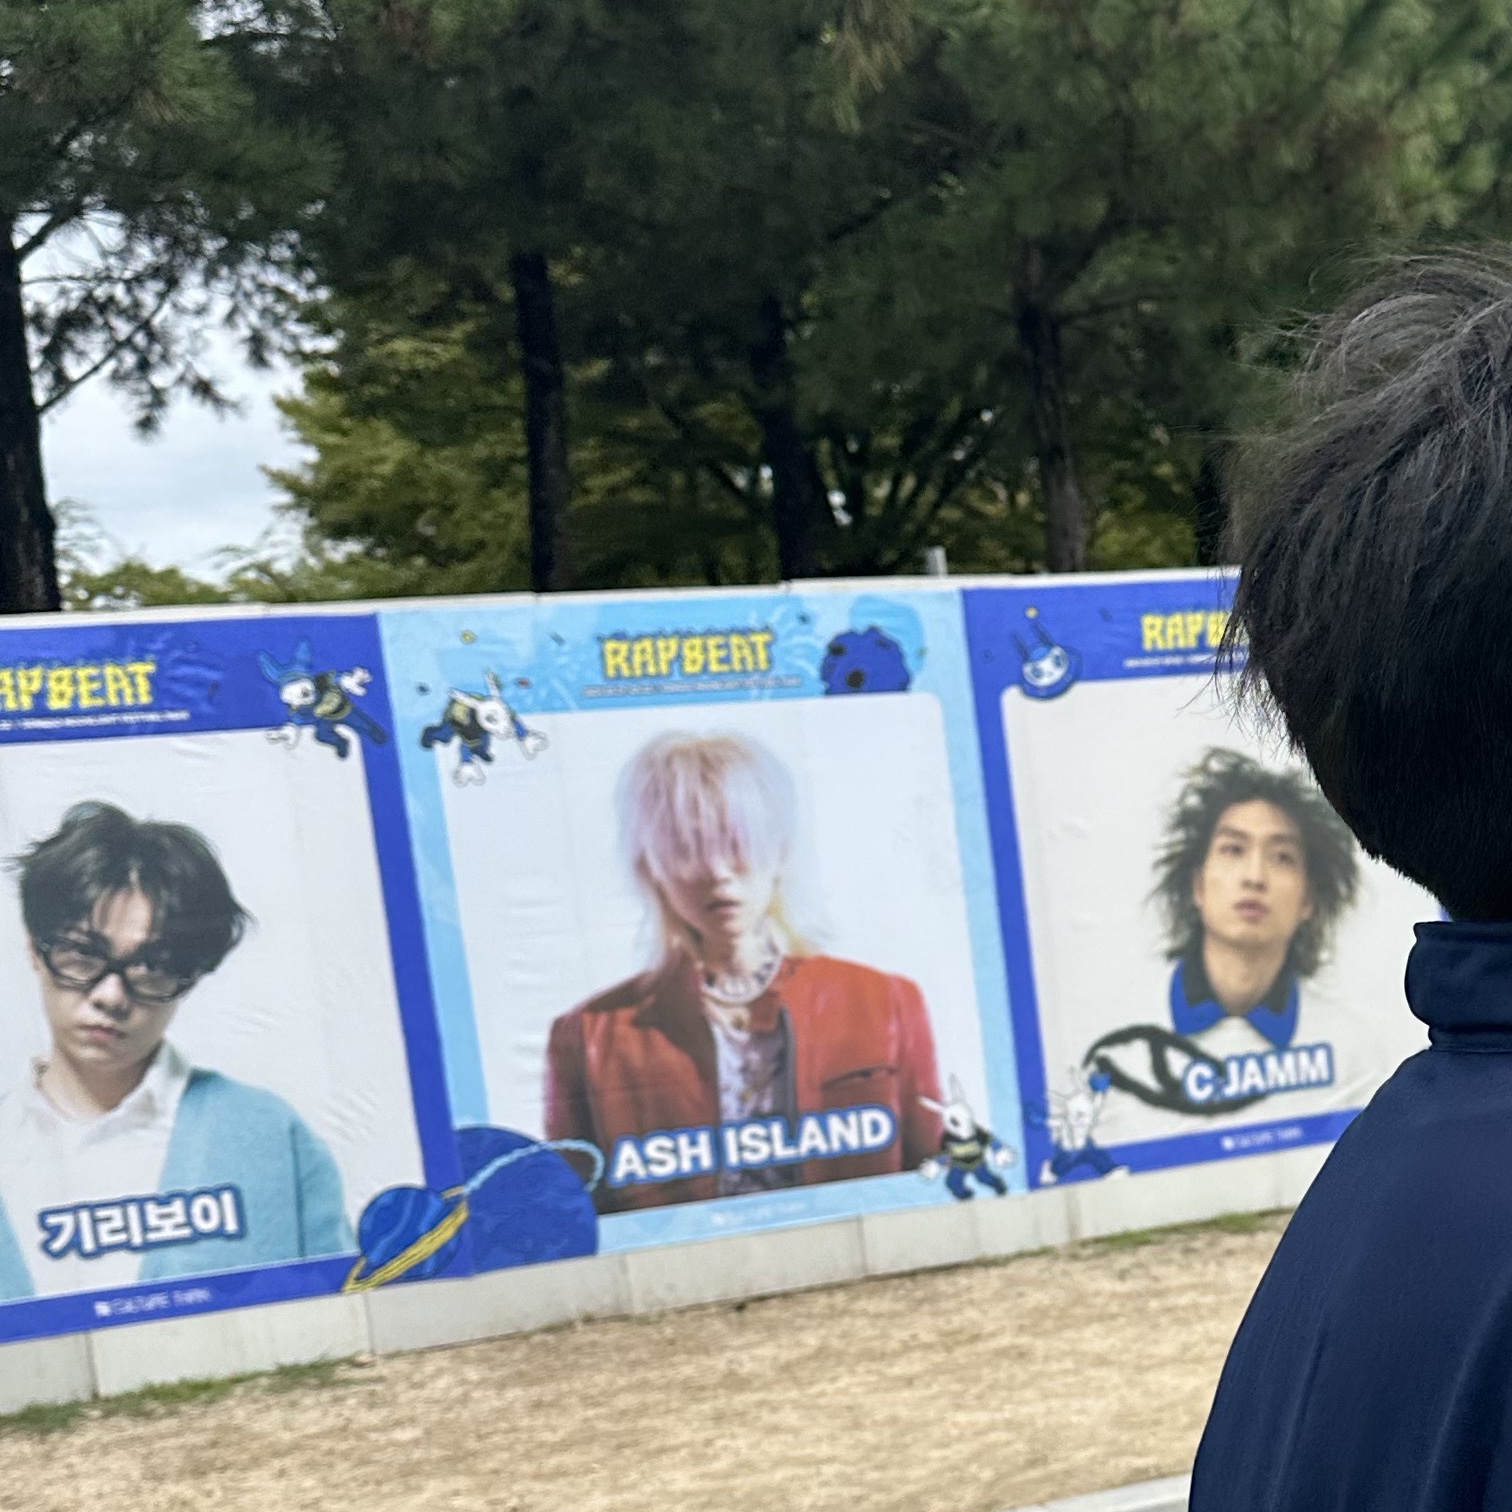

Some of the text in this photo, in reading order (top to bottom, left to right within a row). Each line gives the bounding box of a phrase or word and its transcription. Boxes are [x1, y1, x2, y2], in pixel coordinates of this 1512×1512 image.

[603, 630, 773, 680] RAPBEAT
[0, 660, 157, 711] APBEAT
[1184, 1046, 1331, 1101] C JAMM
[613, 1107, 894, 1182] ASH ISLAND
[43, 1187, 241, 1256] 기리보이
